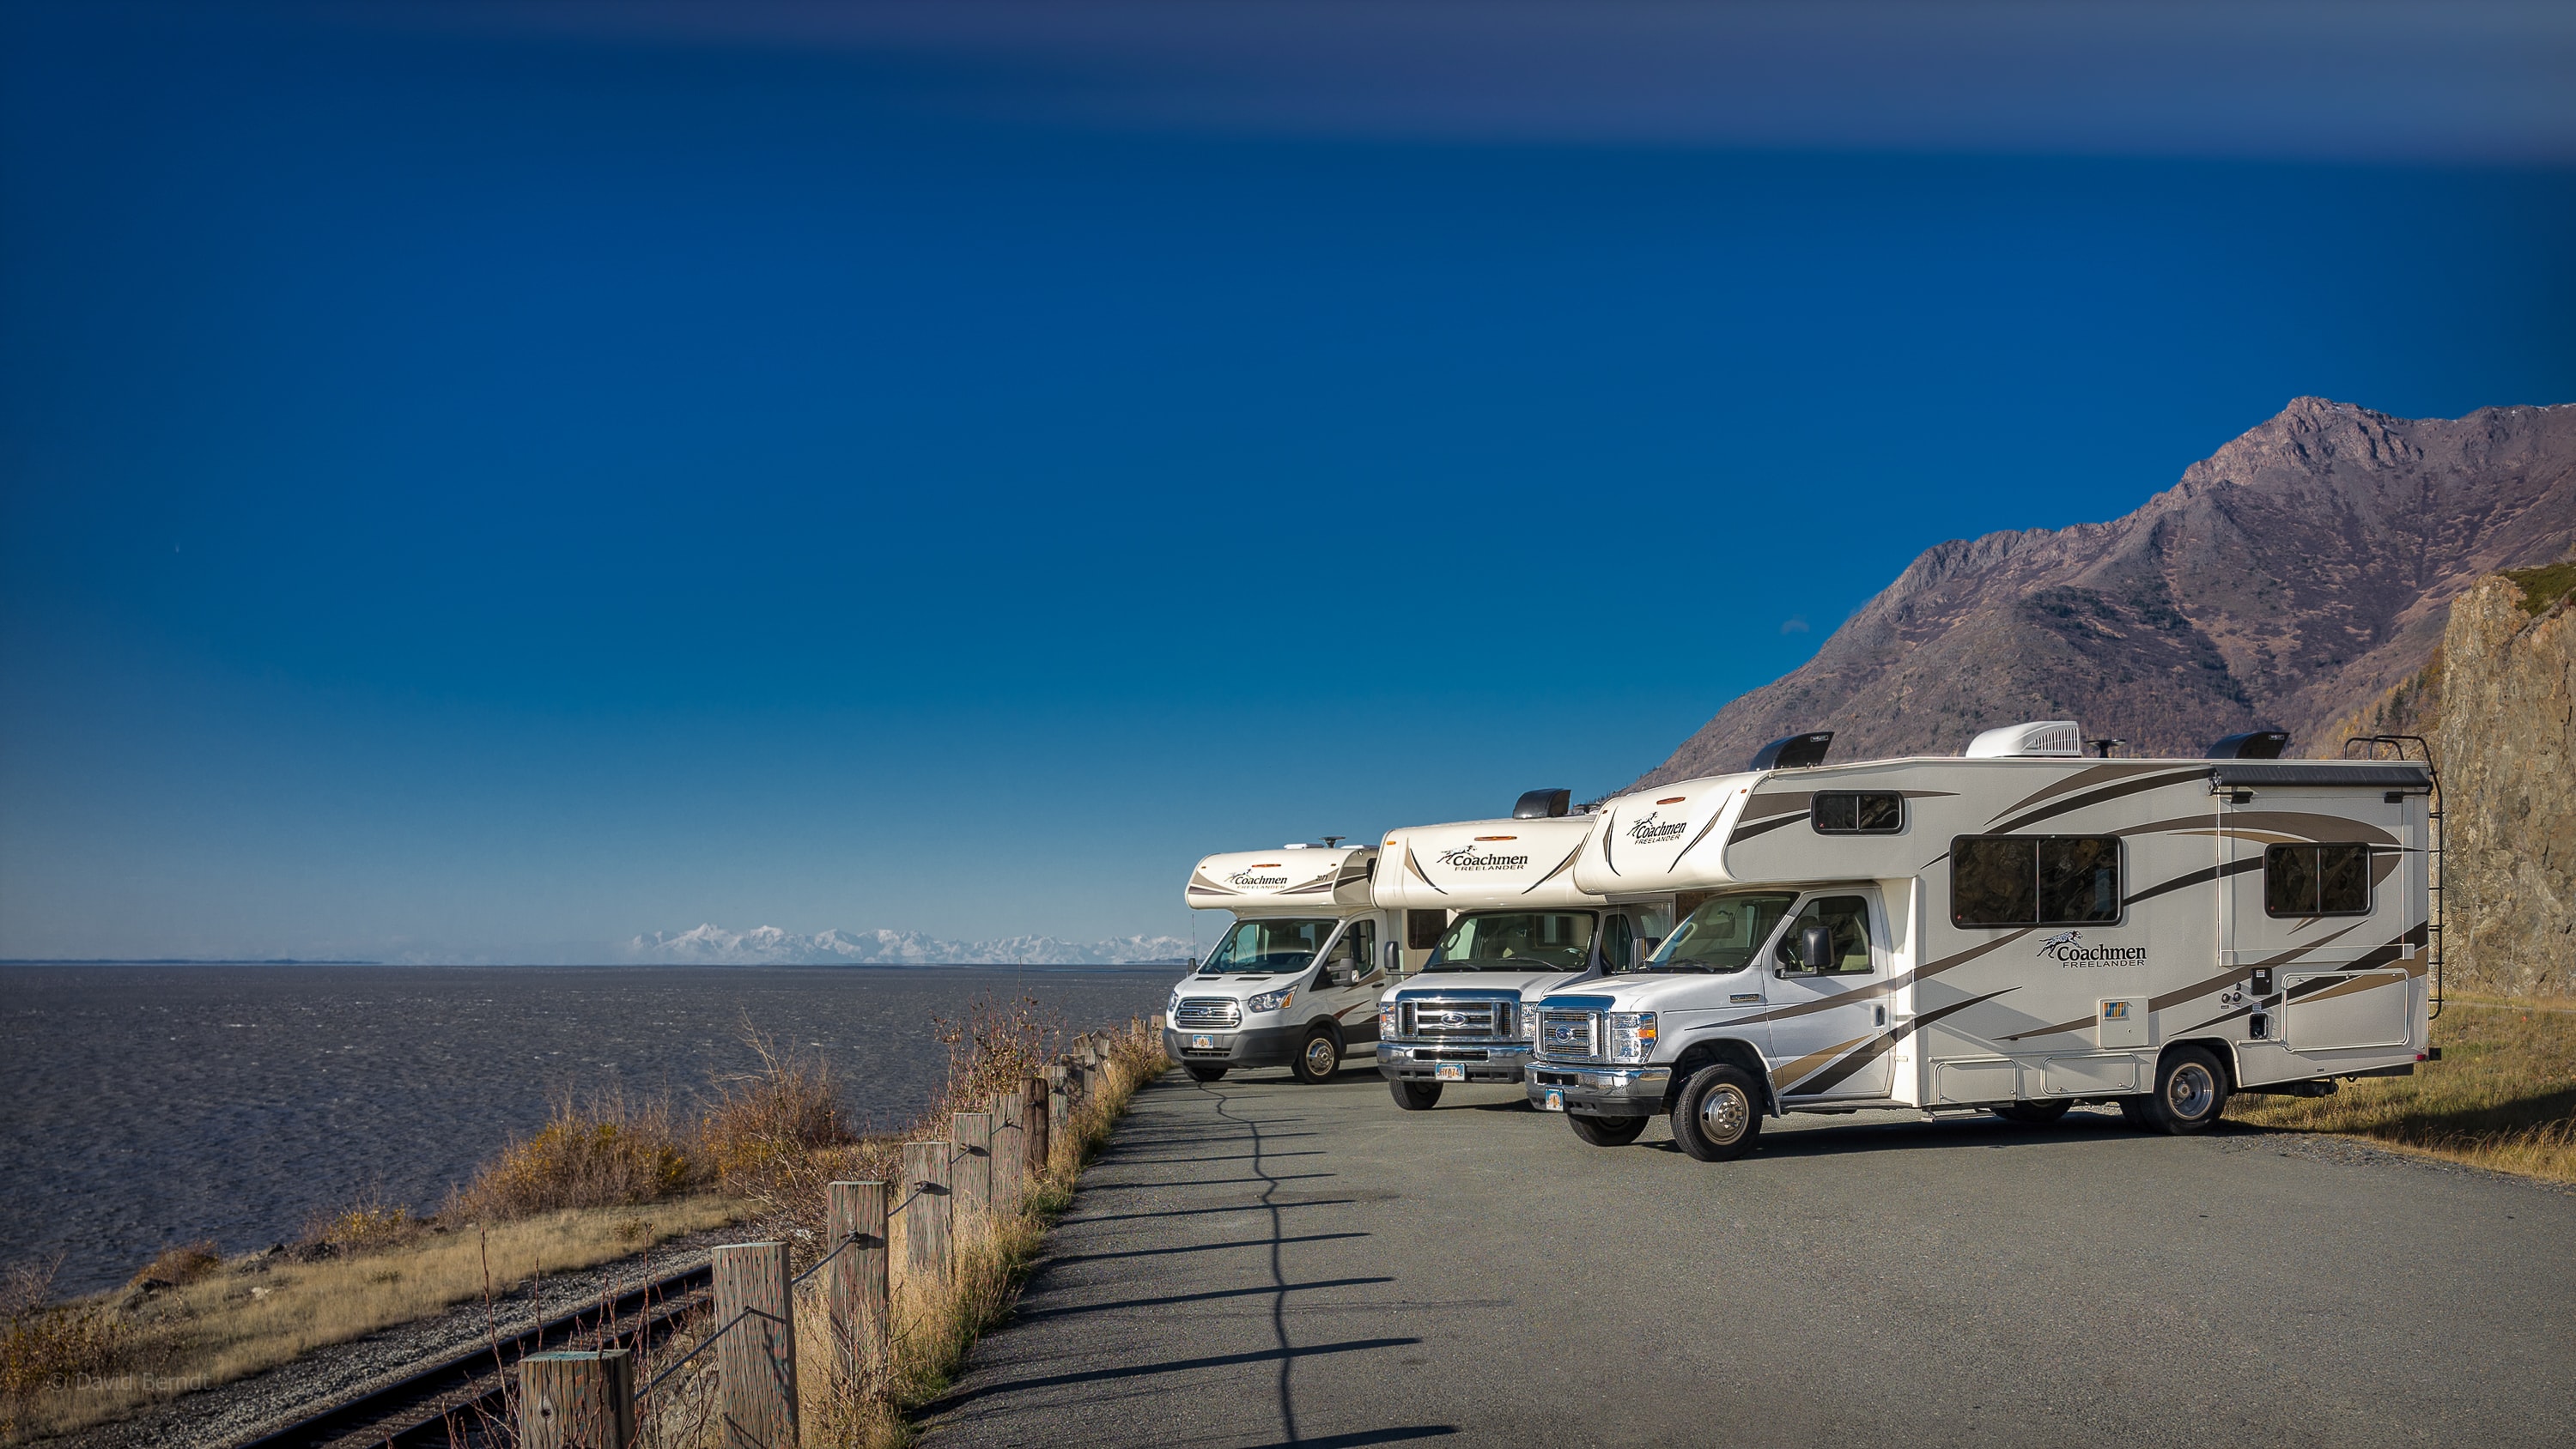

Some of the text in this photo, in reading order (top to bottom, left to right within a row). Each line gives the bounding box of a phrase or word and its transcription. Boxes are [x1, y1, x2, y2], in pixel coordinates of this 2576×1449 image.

[1636, 822, 1687, 840] Coachmen
[1634, 834, 1680, 845] FREELANDER
[1453, 853, 1528, 866] Coachmen
[1235, 876, 1288, 885] Coachmen
[2057, 943, 2147, 961] Coachmen
[2063, 960, 2145, 968] FREELANDER
